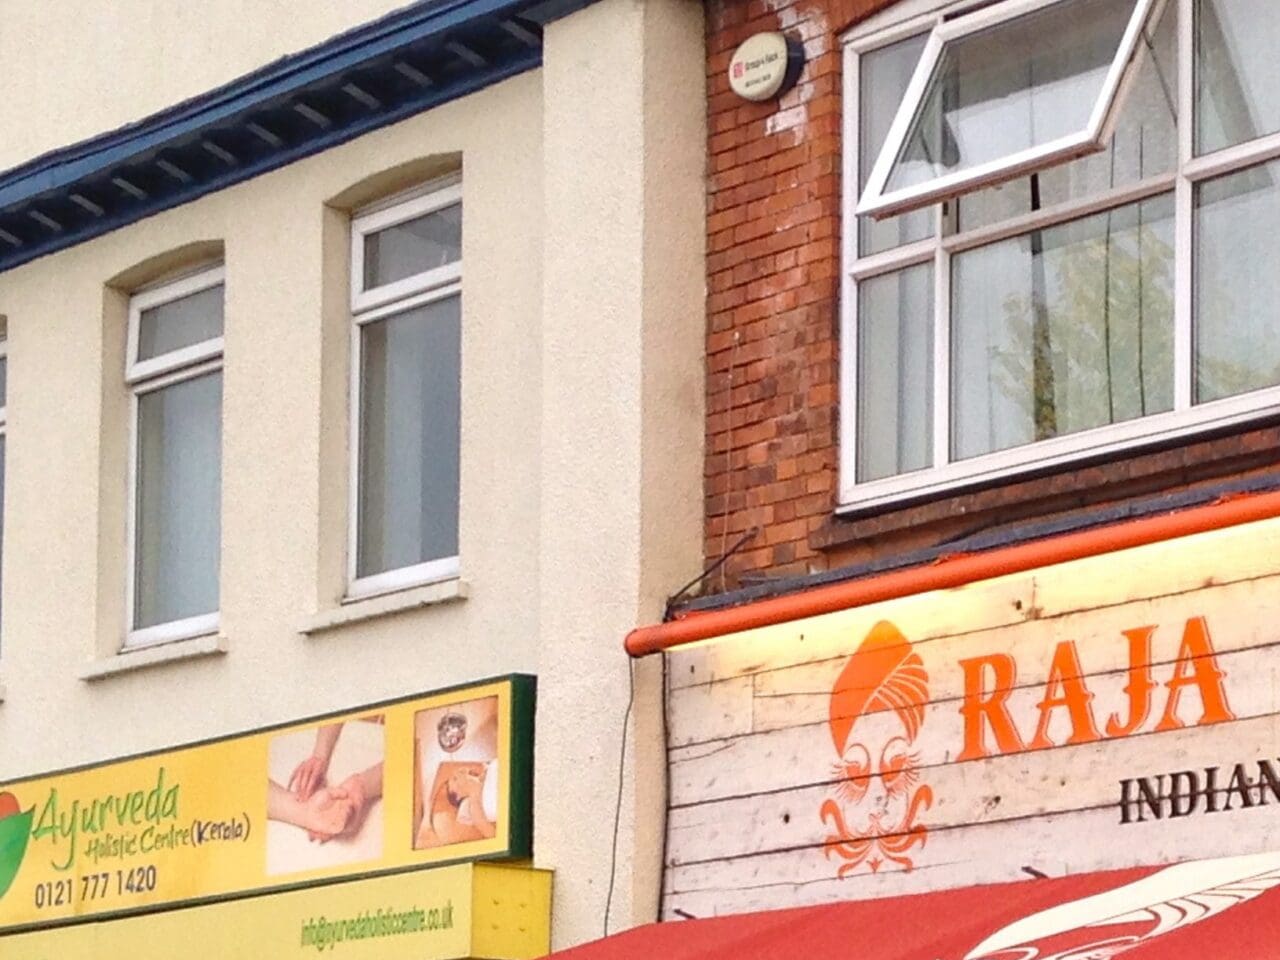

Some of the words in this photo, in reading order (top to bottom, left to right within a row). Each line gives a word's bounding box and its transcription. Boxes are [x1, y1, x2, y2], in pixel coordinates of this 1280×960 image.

[955, 614, 1238, 763] RAJA
[32, 767, 180, 871] Ayurveda
[84, 828, 138, 864] Holistic
[140, 823, 189, 855] Centre
[34, 878, 73, 909] 0121
[81, 872, 110, 902] 777
[117, 864, 157, 897] 1420
